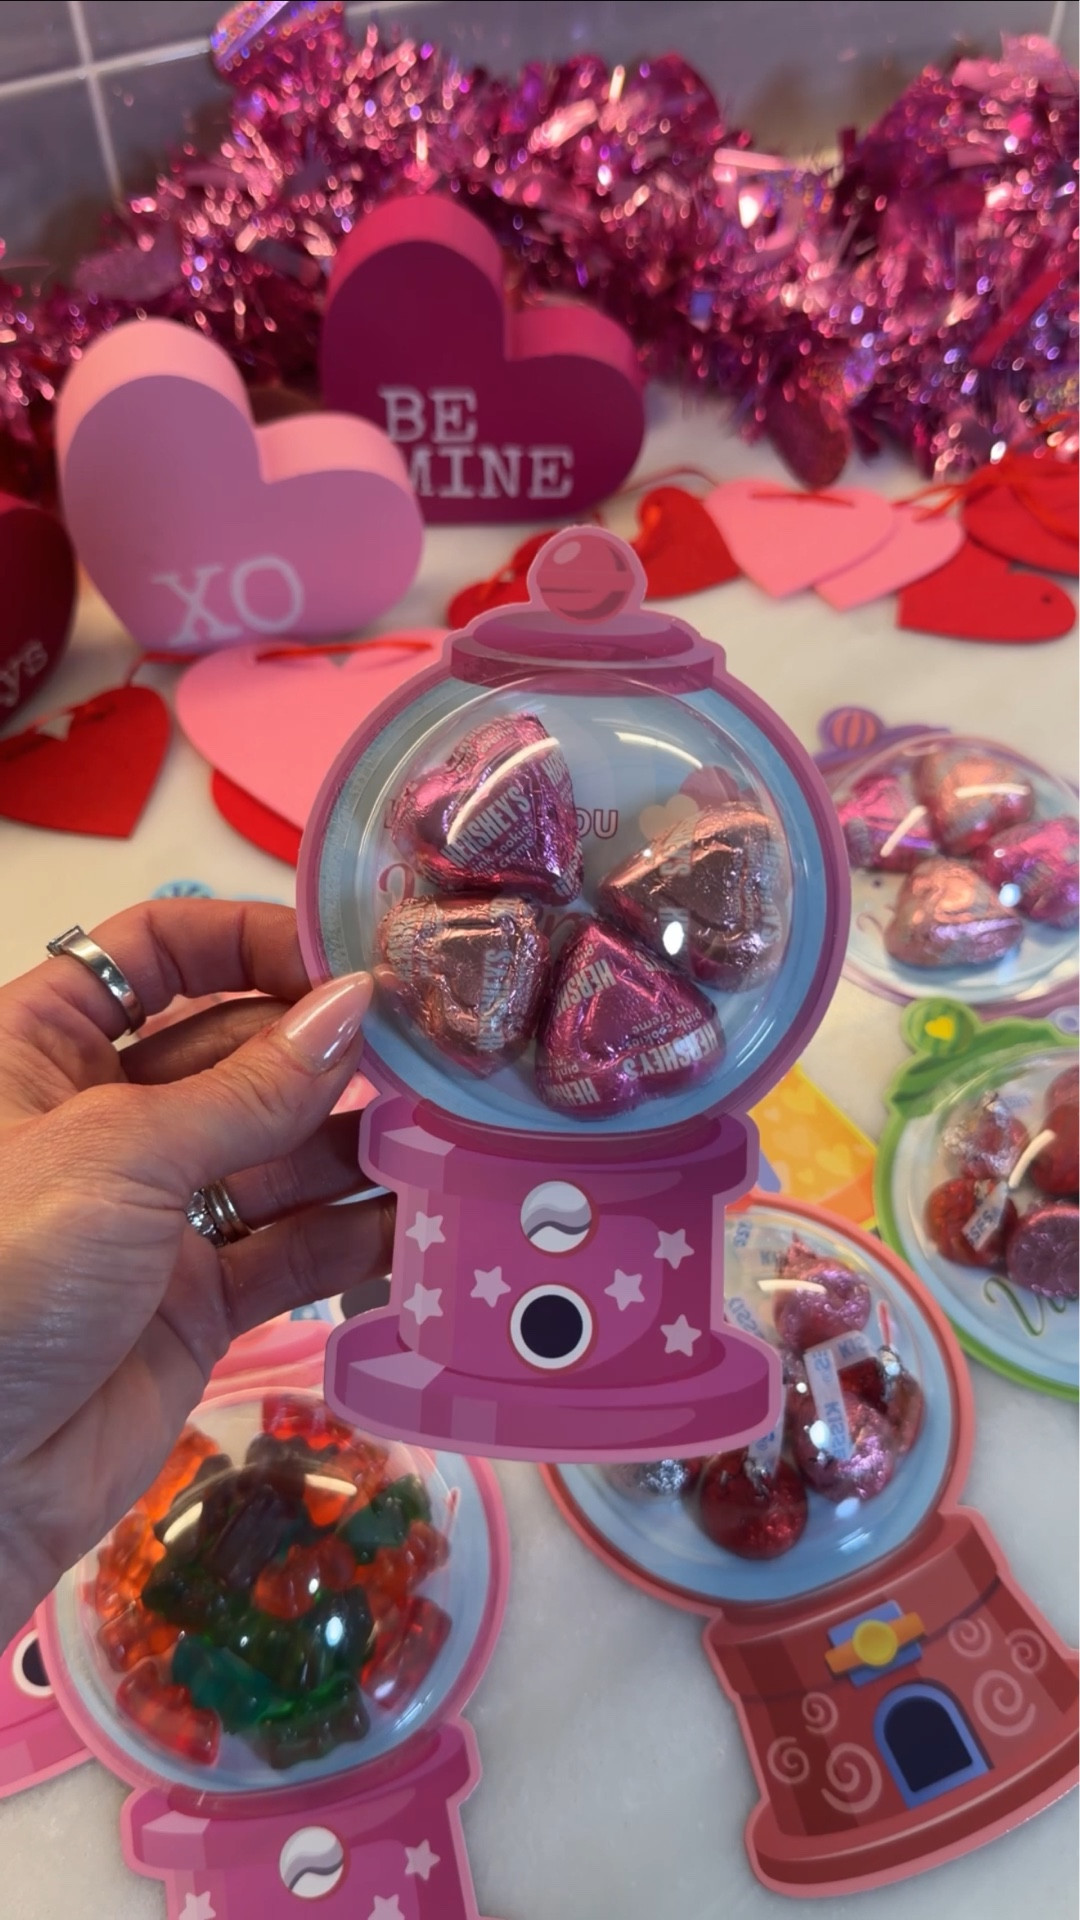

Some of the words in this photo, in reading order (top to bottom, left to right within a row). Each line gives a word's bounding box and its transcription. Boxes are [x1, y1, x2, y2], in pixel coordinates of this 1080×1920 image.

[378, 385, 478, 443] BE
[409, 444, 575, 499] MINE
[150, 554, 304, 648] XO
[440, 785, 531, 869] HERSHEY'S
[494, 818, 536, 857] cookies
[577, 807, 619, 839] OU
[500, 834, 536, 870] creme
[624, 1022, 673, 1051] cookies
[631, 1013, 672, 1035] creme
[677, 1007, 703, 1032] pink
[622, 1021, 719, 1082] HERSHEY'S
